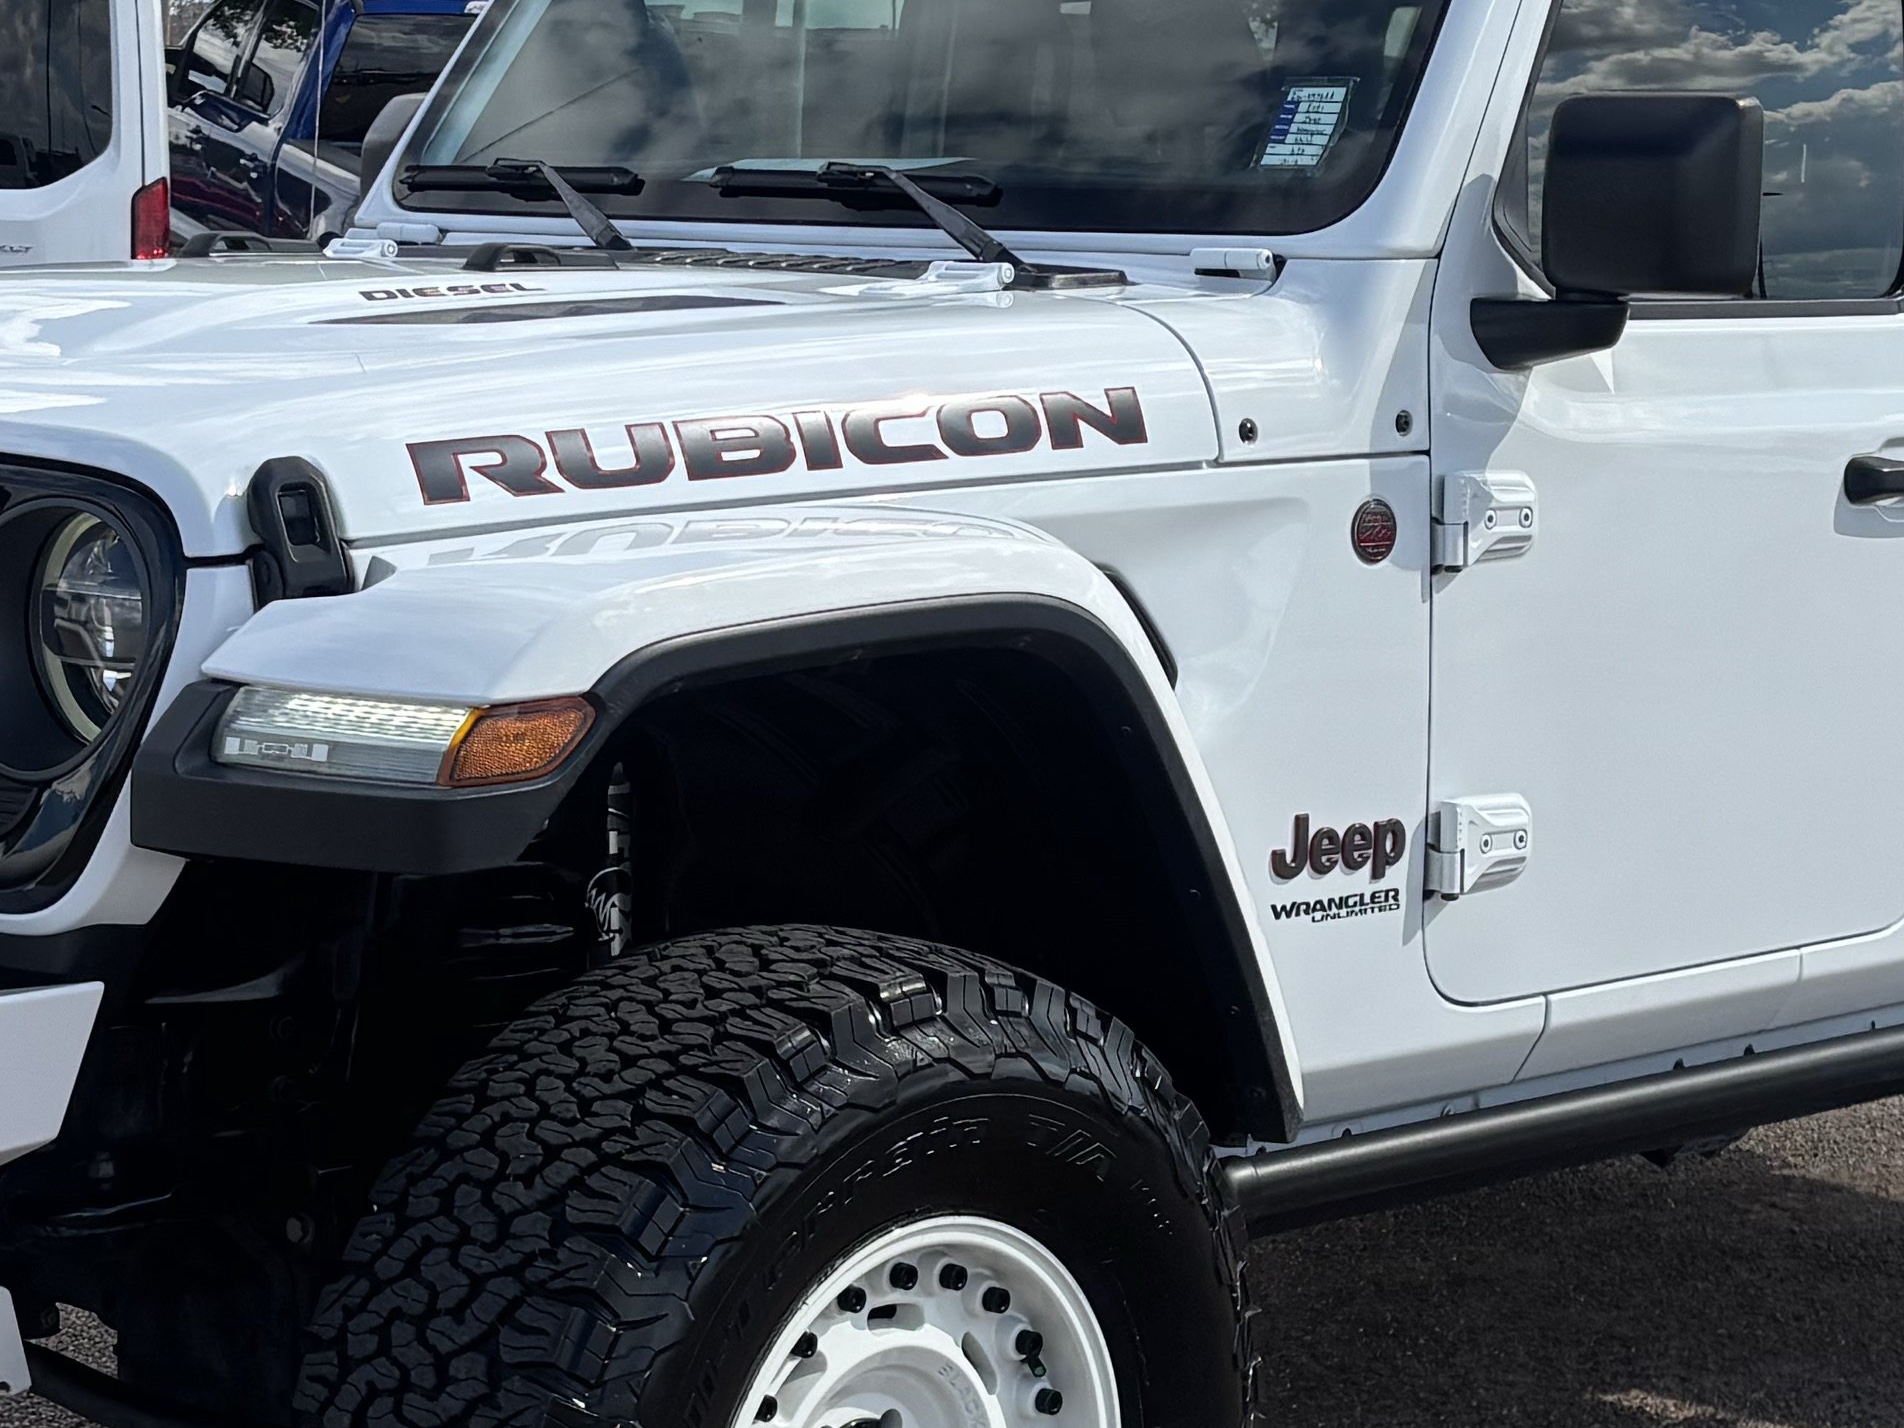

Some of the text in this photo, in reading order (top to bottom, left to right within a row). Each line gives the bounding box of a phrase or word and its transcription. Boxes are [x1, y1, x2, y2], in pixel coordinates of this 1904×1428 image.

[358, 283, 547, 302] DIESEL
[405, 386, 1149, 506] RUBICON
[1269, 812, 1407, 881] Jeep
[1270, 887, 1401, 921] WRANGLER
[1311, 903, 1401, 923] UNLIMITED
